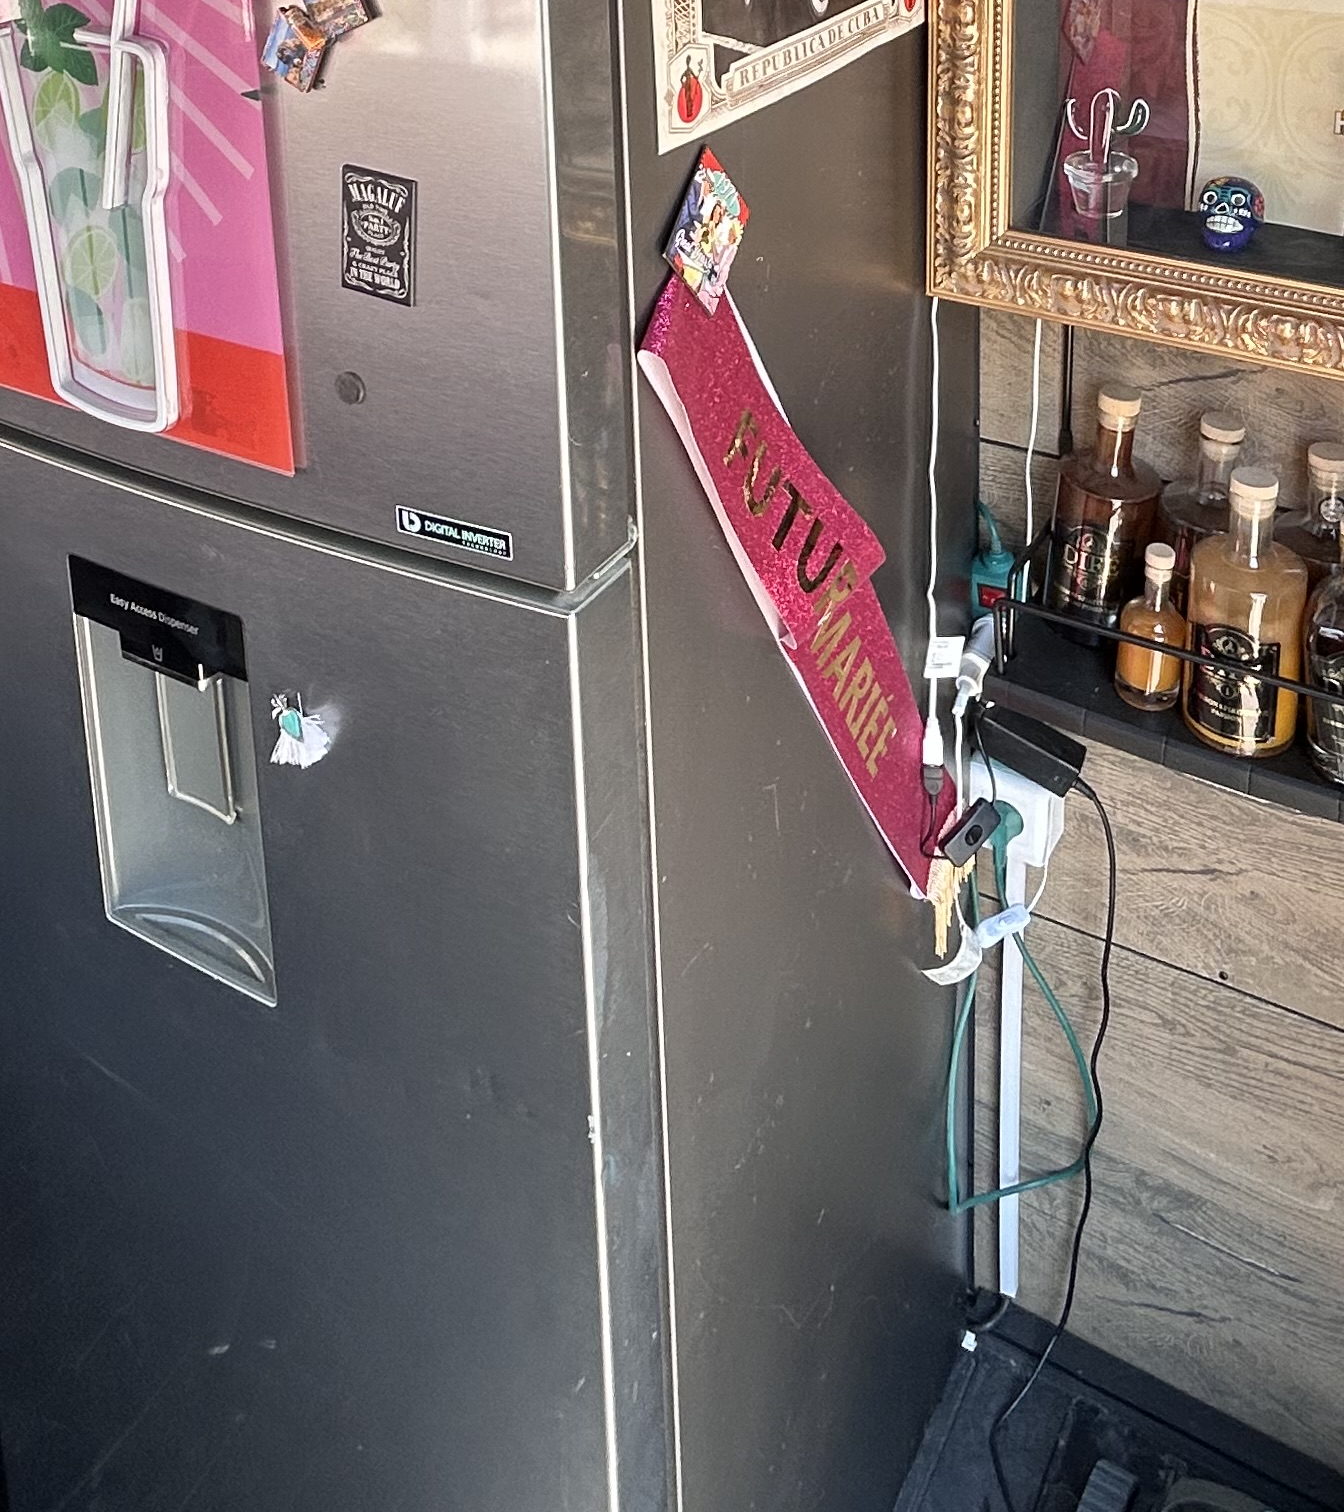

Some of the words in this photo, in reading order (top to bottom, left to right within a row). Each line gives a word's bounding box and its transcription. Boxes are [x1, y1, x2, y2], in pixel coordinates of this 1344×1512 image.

[739, 36, 825, 87] REPUBLICA
[828, 25, 843, 45] DE
[848, 7, 880, 34] CUBA
[348, 183, 406, 213] MAGALUF
[361, 220, 392, 235] PARTY
[350, 267, 358, 278] IN
[359, 268, 373, 282] THE
[374, 272, 401, 289] WORLD
[424, 520, 461, 539] DIGITAL
[461, 530, 506, 550] INVERTER
[110, 593, 129, 610] Easy
[130, 601, 157, 619] Access
[158, 611, 199, 635] Dispenser
[810, 604, 898, 780] MARIÉE
